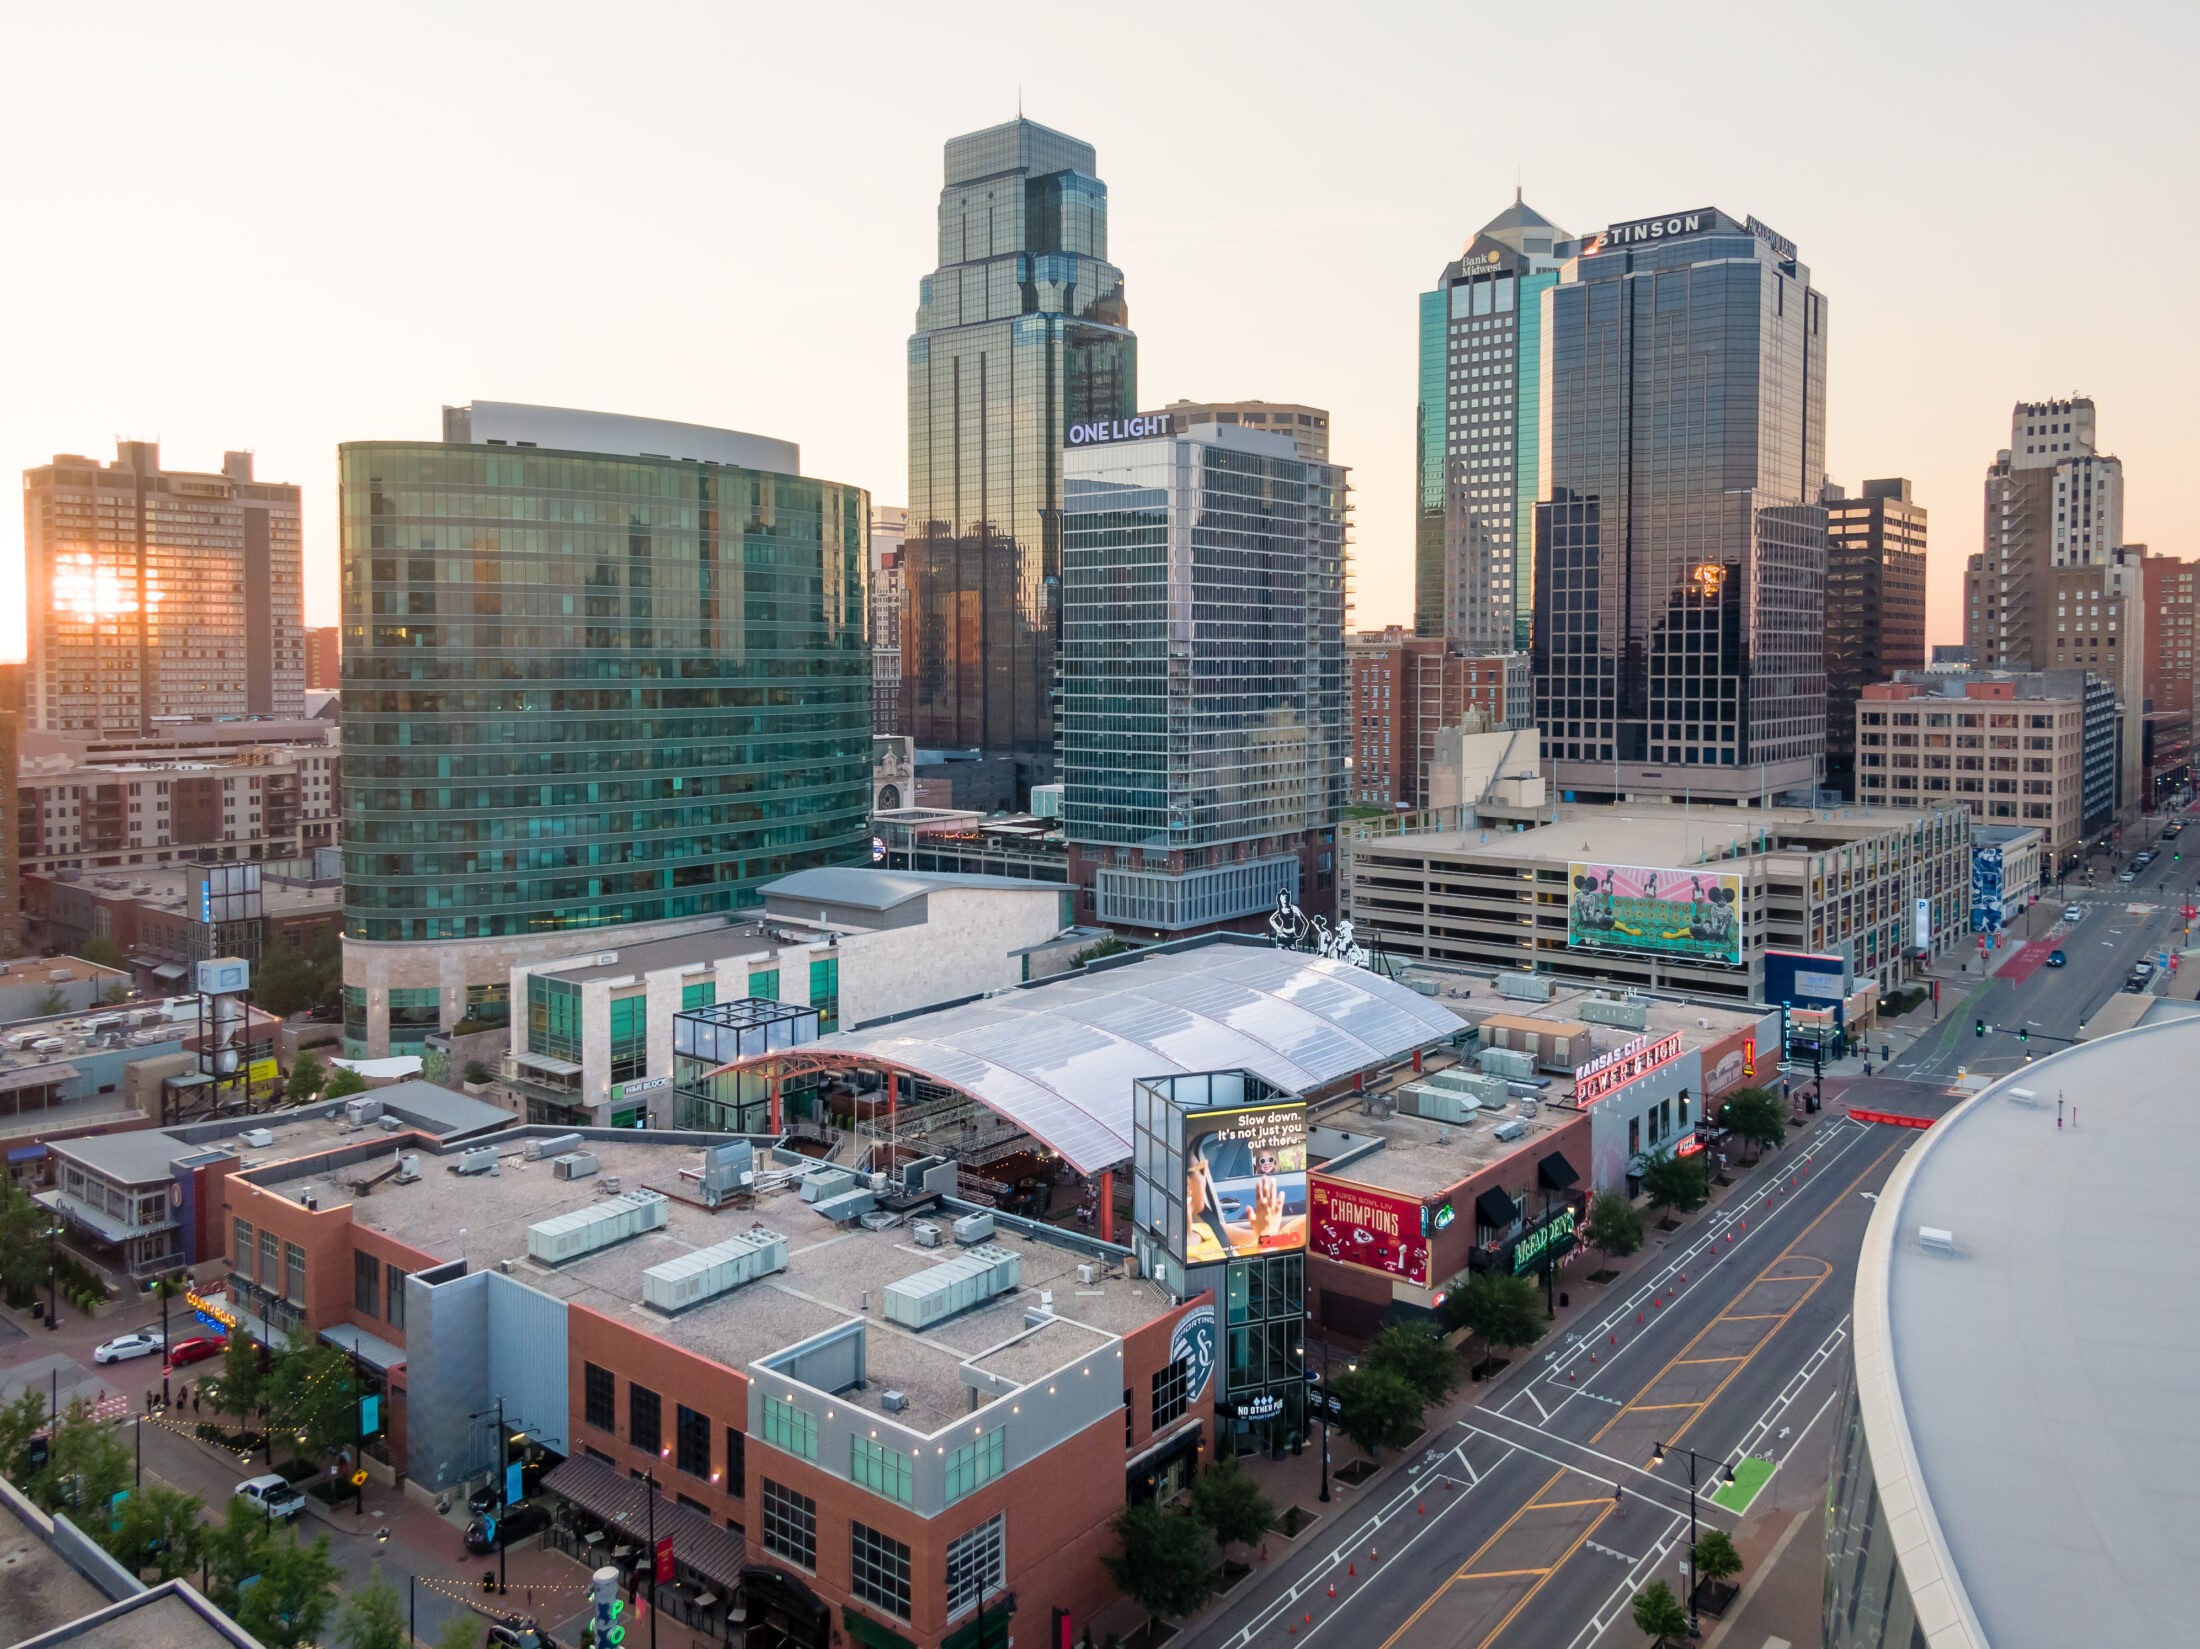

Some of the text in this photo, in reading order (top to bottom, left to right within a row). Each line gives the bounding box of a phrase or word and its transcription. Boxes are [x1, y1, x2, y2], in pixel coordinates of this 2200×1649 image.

[1597, 215, 1700, 247] STINSON
[1462, 253, 1488, 267] Bank
[1462, 262, 1502, 277] Midwest
[1069, 414, 1170, 444] ONE LIGHT
[1918, 901, 1926, 910] P
[1576, 1034, 1648, 1081] KANSAS CITY
[1577, 1062, 1628, 1105] POWER
[1646, 1034, 1684, 1069] LIGHT
[1238, 1111, 1302, 1126] Slow down.
[1218, 1123, 1302, 1141] It's not just you
[1247, 1135, 1301, 1150] out there.
[1335, 1191, 1357, 1202] SUPER
[1358, 1196, 1379, 1208] BOWL
[1380, 1201, 1393, 1210] LIV
[1331, 1198, 1399, 1237] CHAMPIONS
[1327, 1243, 1340, 1255] 15
[186, 1291, 237, 1328] COUNTY ROAD
[1174, 1316, 1215, 1346] SPORTING
[1237, 1405, 1249, 1416] NO
[1250, 1402, 1273, 1415] OTHER
